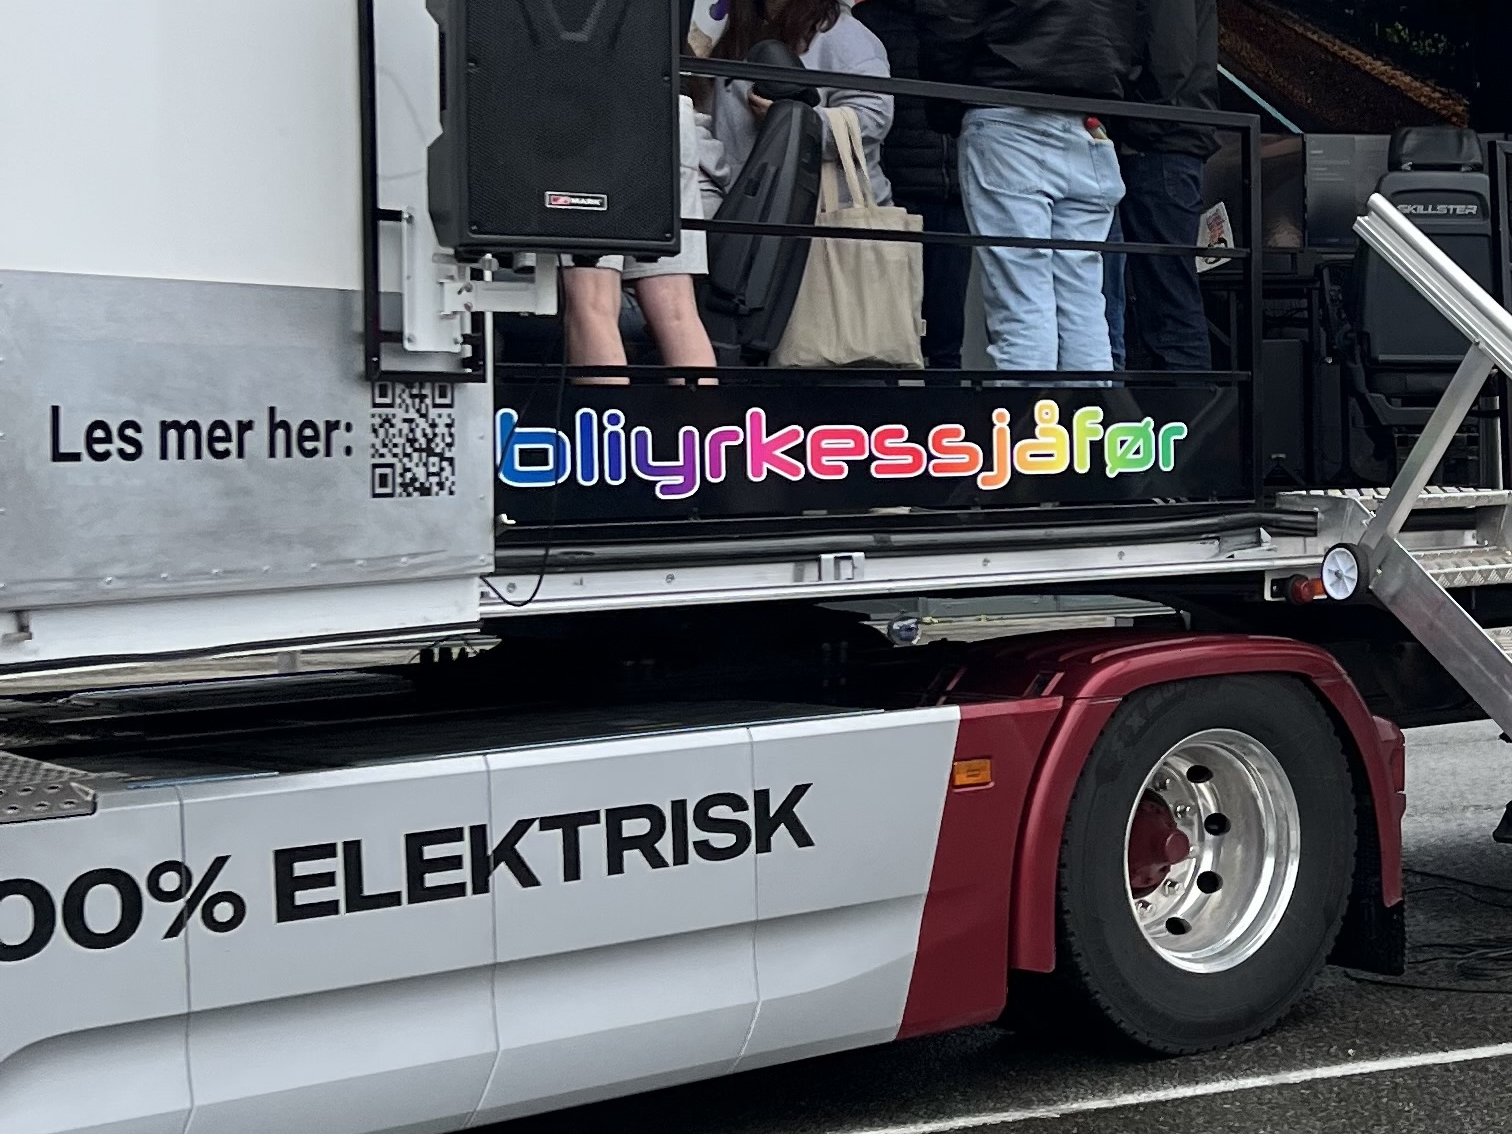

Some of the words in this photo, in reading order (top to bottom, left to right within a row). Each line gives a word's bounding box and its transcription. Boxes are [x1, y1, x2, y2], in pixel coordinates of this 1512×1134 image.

[1397, 204, 1478, 215] SKILLSTER
[49, 405, 144, 463] Les
[159, 418, 255, 461] mer
[267, 405, 355, 459] her:
[272, 781, 816, 925] ELEKTRISK
